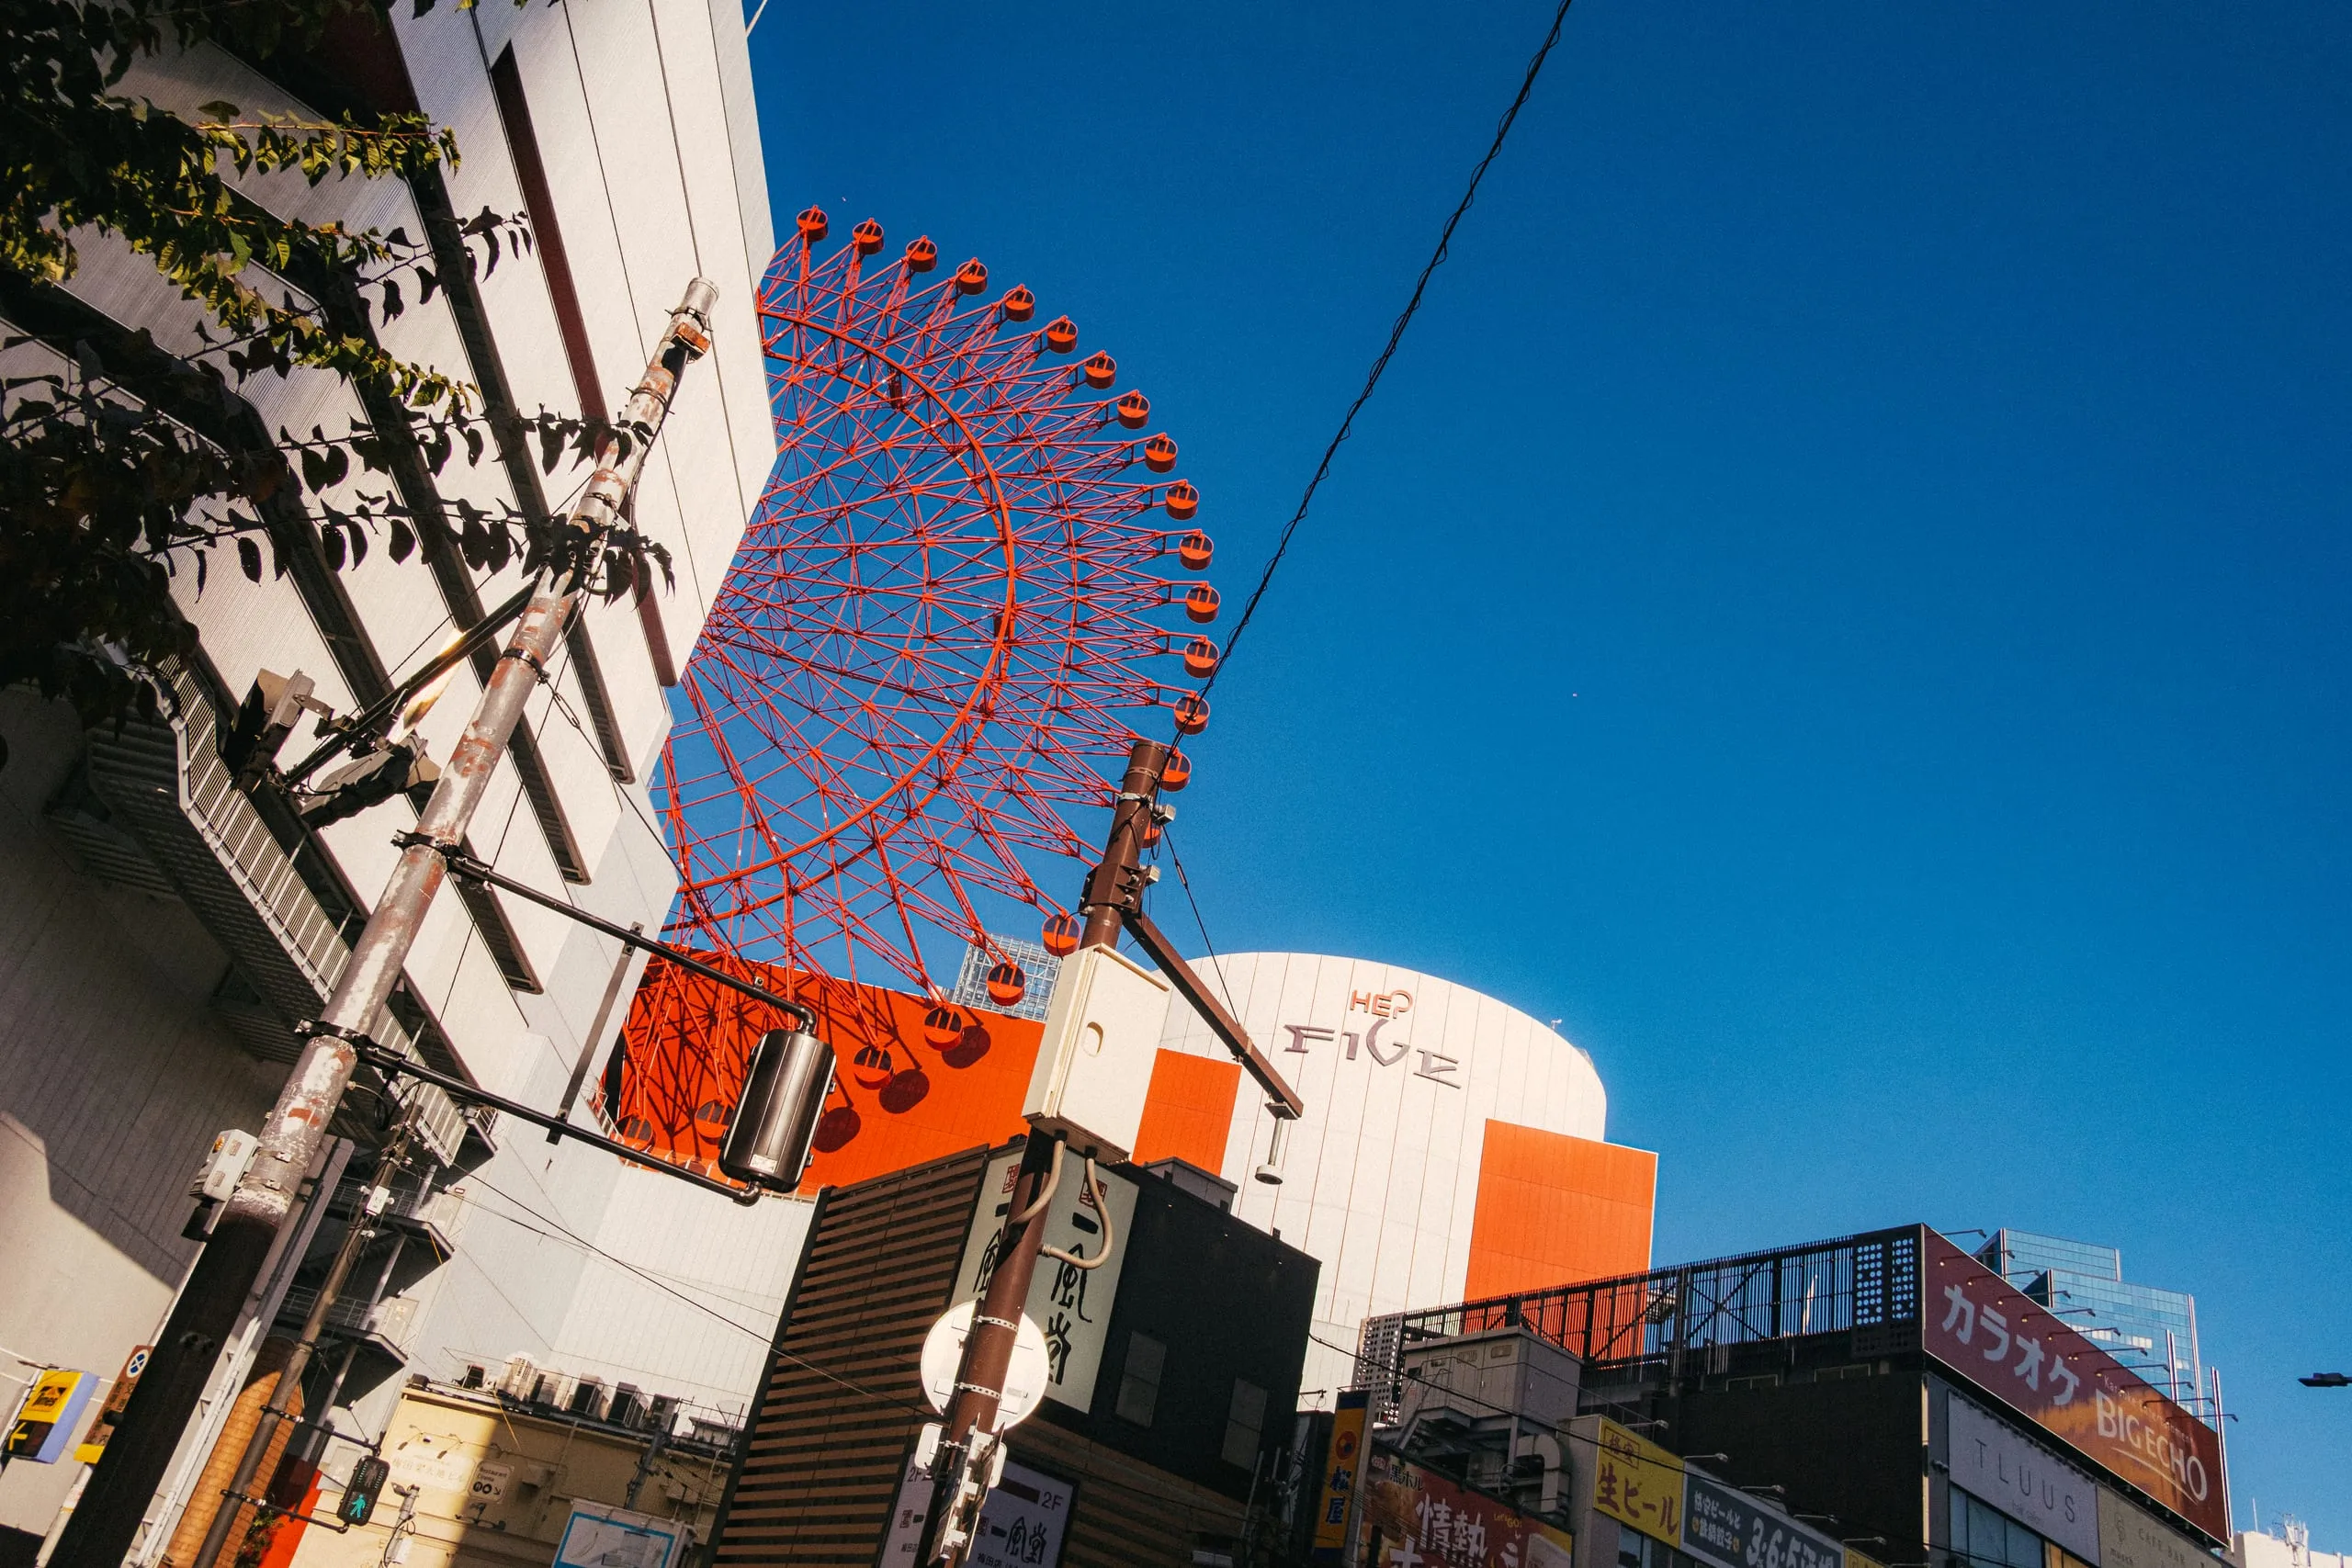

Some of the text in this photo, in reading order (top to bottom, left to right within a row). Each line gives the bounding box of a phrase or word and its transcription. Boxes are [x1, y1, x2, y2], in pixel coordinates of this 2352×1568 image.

[1350, 989, 1414, 1018] HEP
[1941, 1284, 2080, 1406] カラオケ
[907, 1467, 922, 1482] 2F
[2096, 1388, 2142, 1450] BIG
[2144, 1426, 2208, 1502] ECHO
[1041, 1492, 1063, 1511] 2F
[1326, 1465, 1352, 1526] 松屋
[1596, 1462, 1679, 1536] 生ビール
[1974, 1438, 2075, 1523] TLUUS
[990, 1516, 1048, 1564] 一風堂
[1415, 1492, 1488, 1568] 情熱
